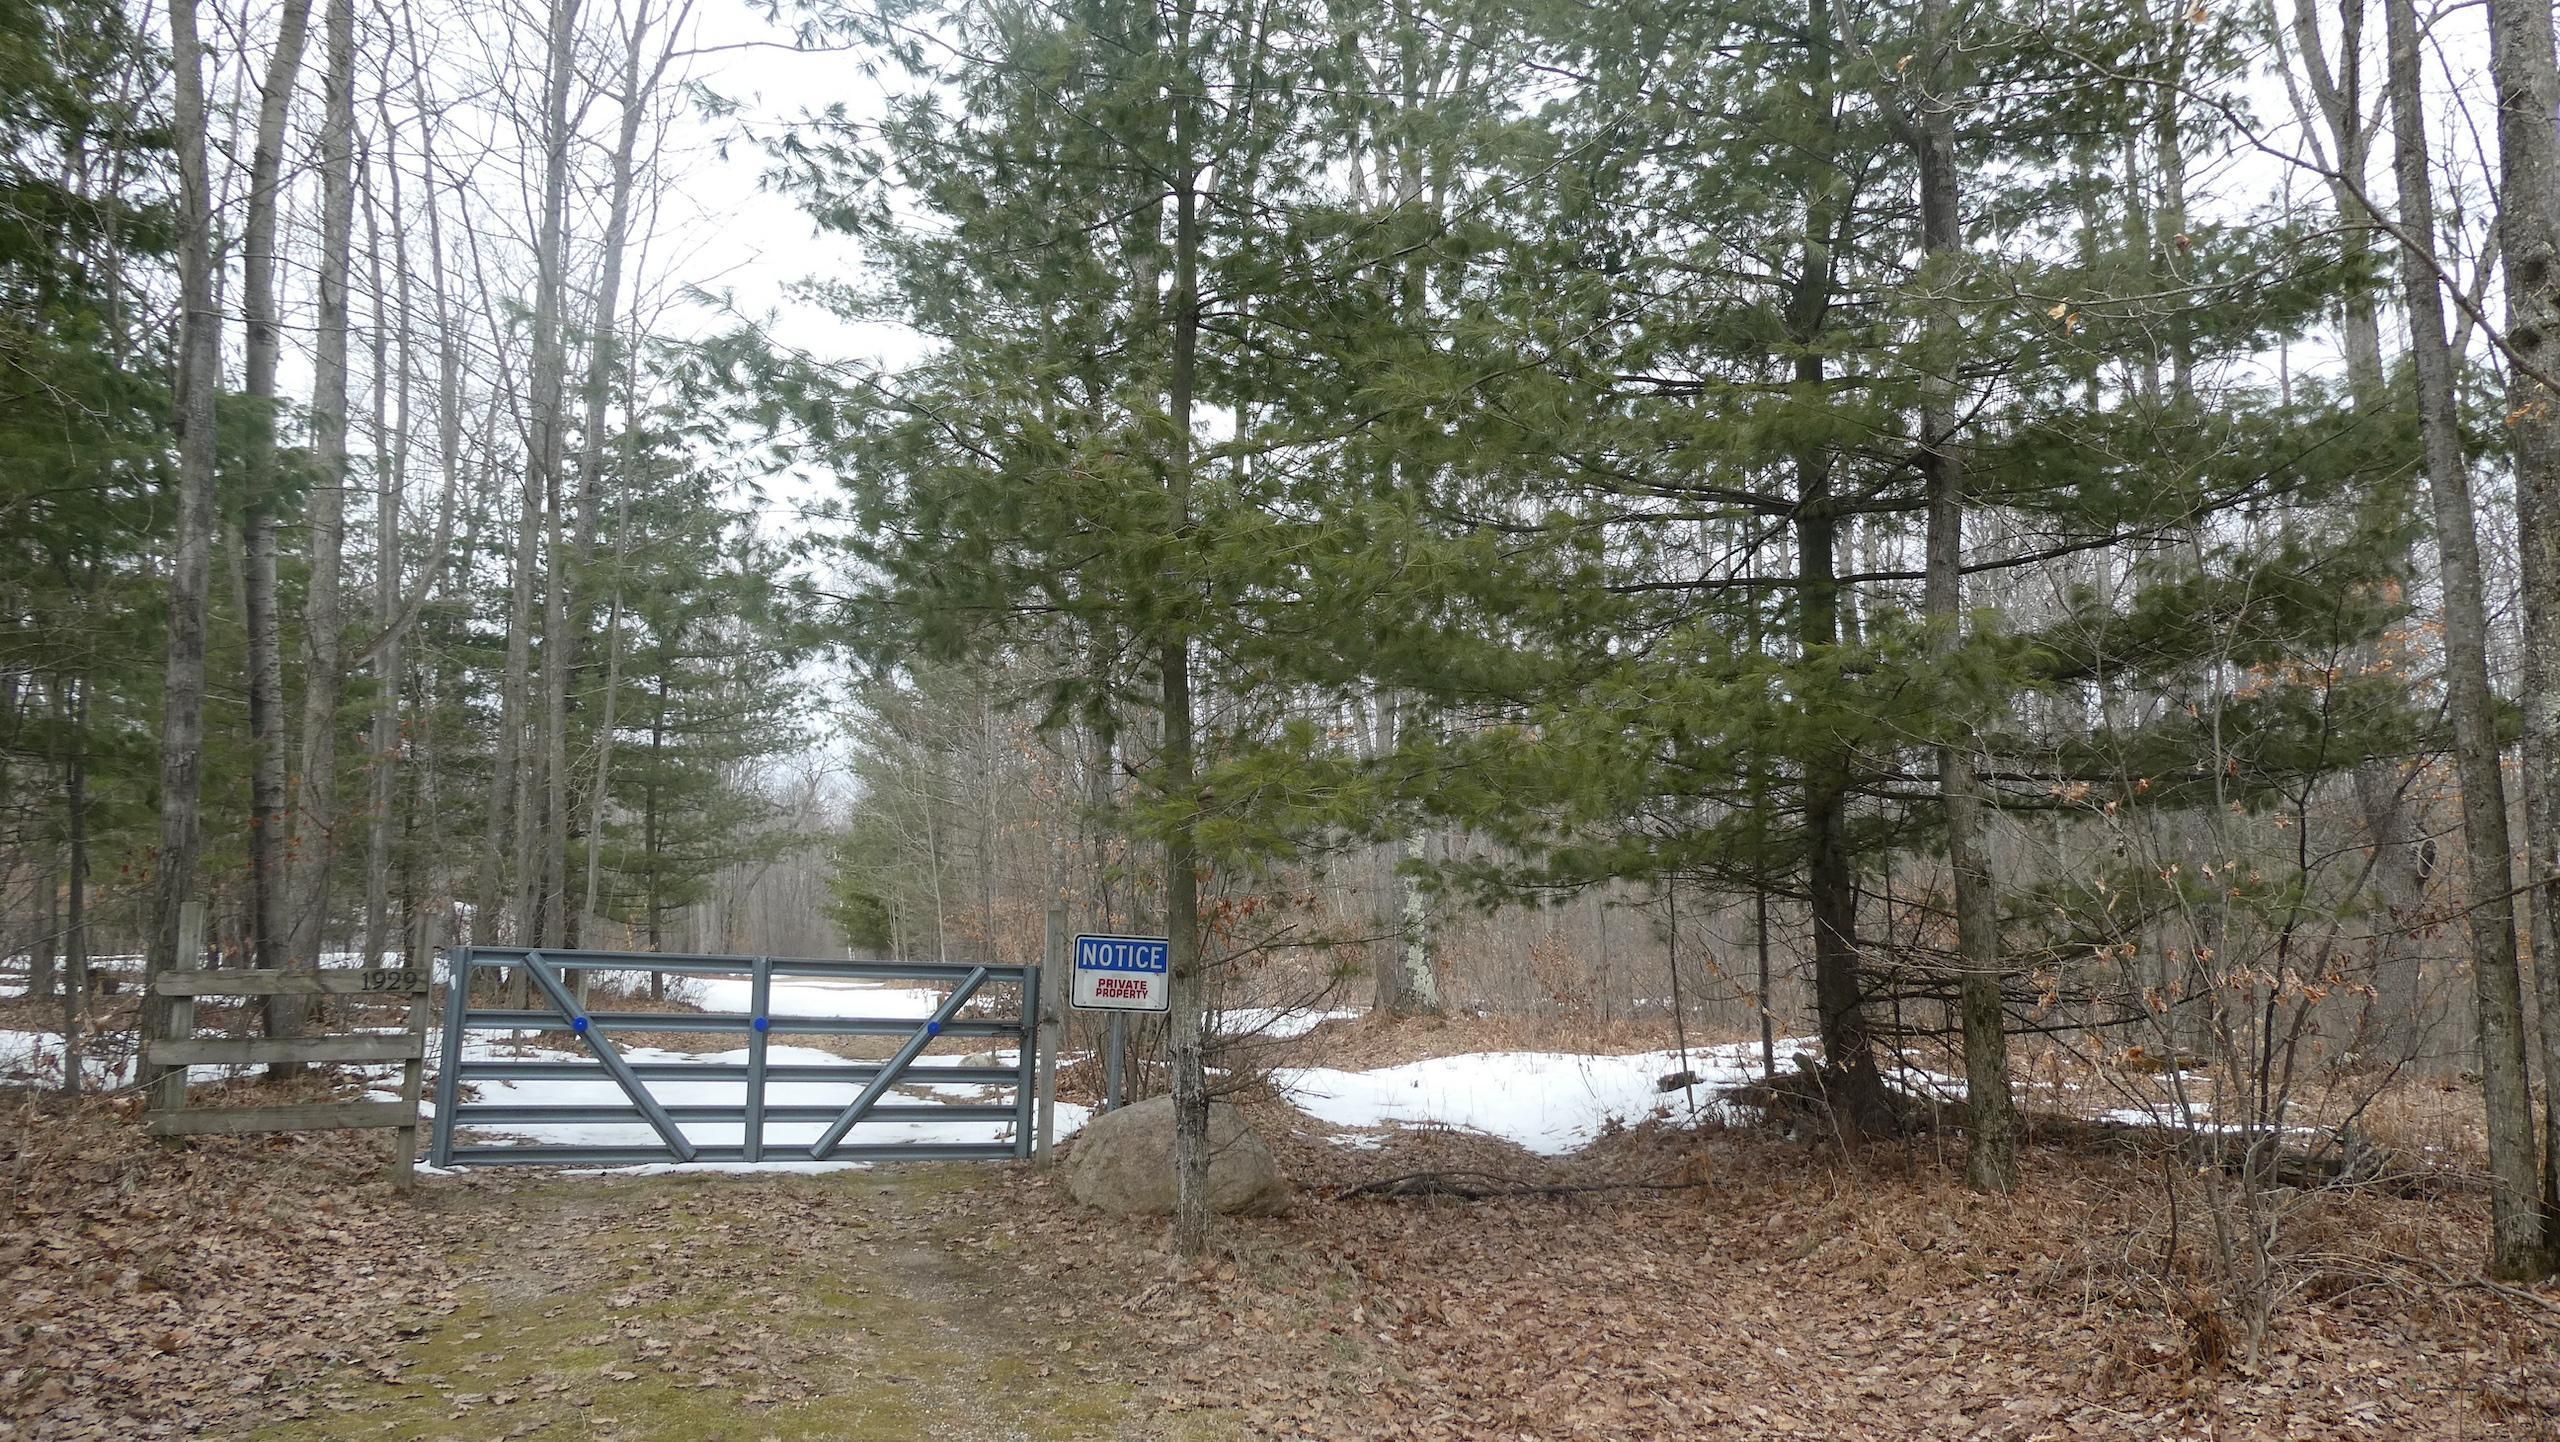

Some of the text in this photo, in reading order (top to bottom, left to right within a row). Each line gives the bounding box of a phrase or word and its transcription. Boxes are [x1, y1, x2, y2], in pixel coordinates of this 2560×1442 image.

[1082, 943, 1163, 969] NOTICE
[361, 971, 417, 991] 1929
[1098, 978, 1147, 990] PRIVATE
[1095, 988, 1149, 999] PROPERTY
